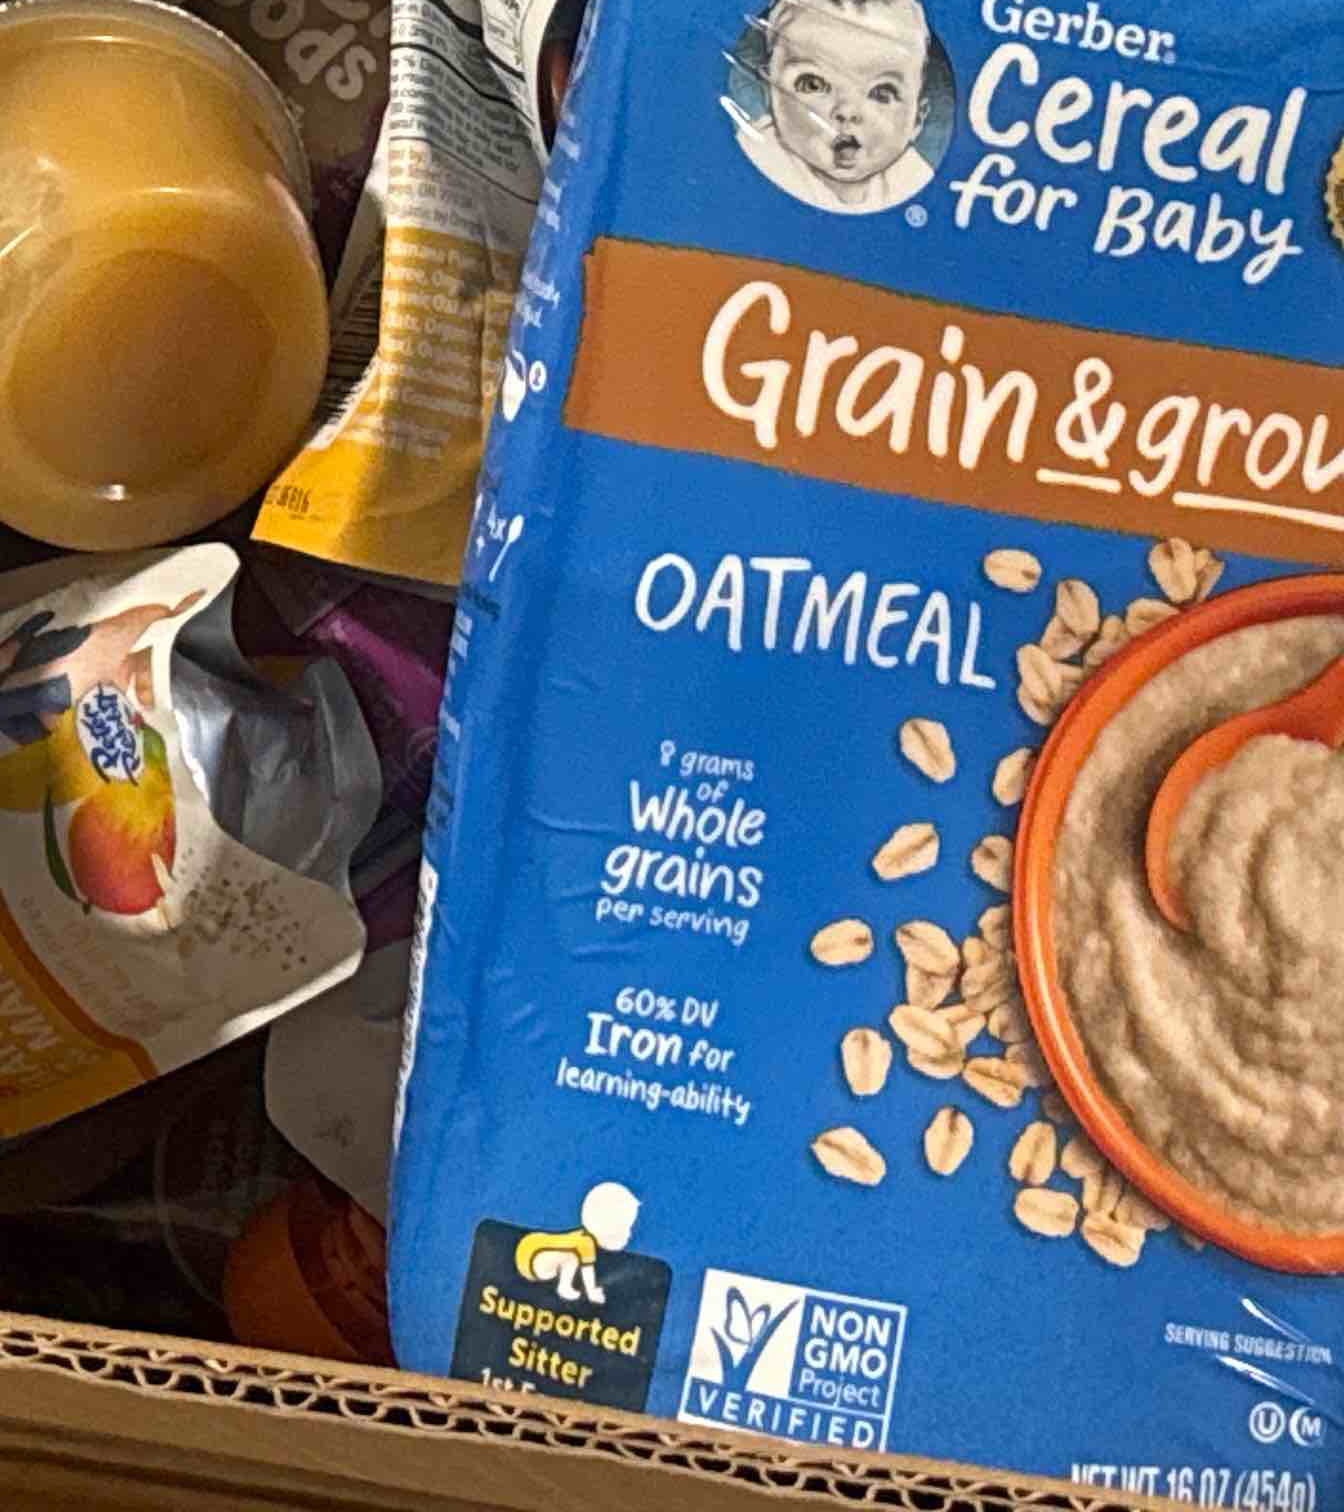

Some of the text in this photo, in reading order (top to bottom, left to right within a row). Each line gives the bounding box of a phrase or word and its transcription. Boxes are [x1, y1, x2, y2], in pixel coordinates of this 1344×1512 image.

[968, 42, 1306, 195] Cereal
[949, 155, 1078, 230] for
[1093, 185, 1301, 285] Baby
[702, 281, 1038, 470] Grain
[1055, 357, 1127, 469] &
[635, 550, 996, 691] OATMEAL
[660, 739, 754, 781] 8 grams
[629, 780, 766, 847] Whole
[695, 779, 729, 804] of
[600, 844, 763, 907] grains
[595, 897, 750, 947] per serving
[615, 986, 718, 1028] 60% DV
[584, 1011, 734, 1072] Iron for
[555, 1056, 751, 1126] learning-ability
[479, 1285, 641, 1357] Supported
[810, 1305, 891, 1347] NON
[508, 1336, 592, 1387] Sitter
[801, 1337, 887, 1379] GMO
[692, 1384, 878, 1452] VERIFIED
[795, 1370, 880, 1415] Project
